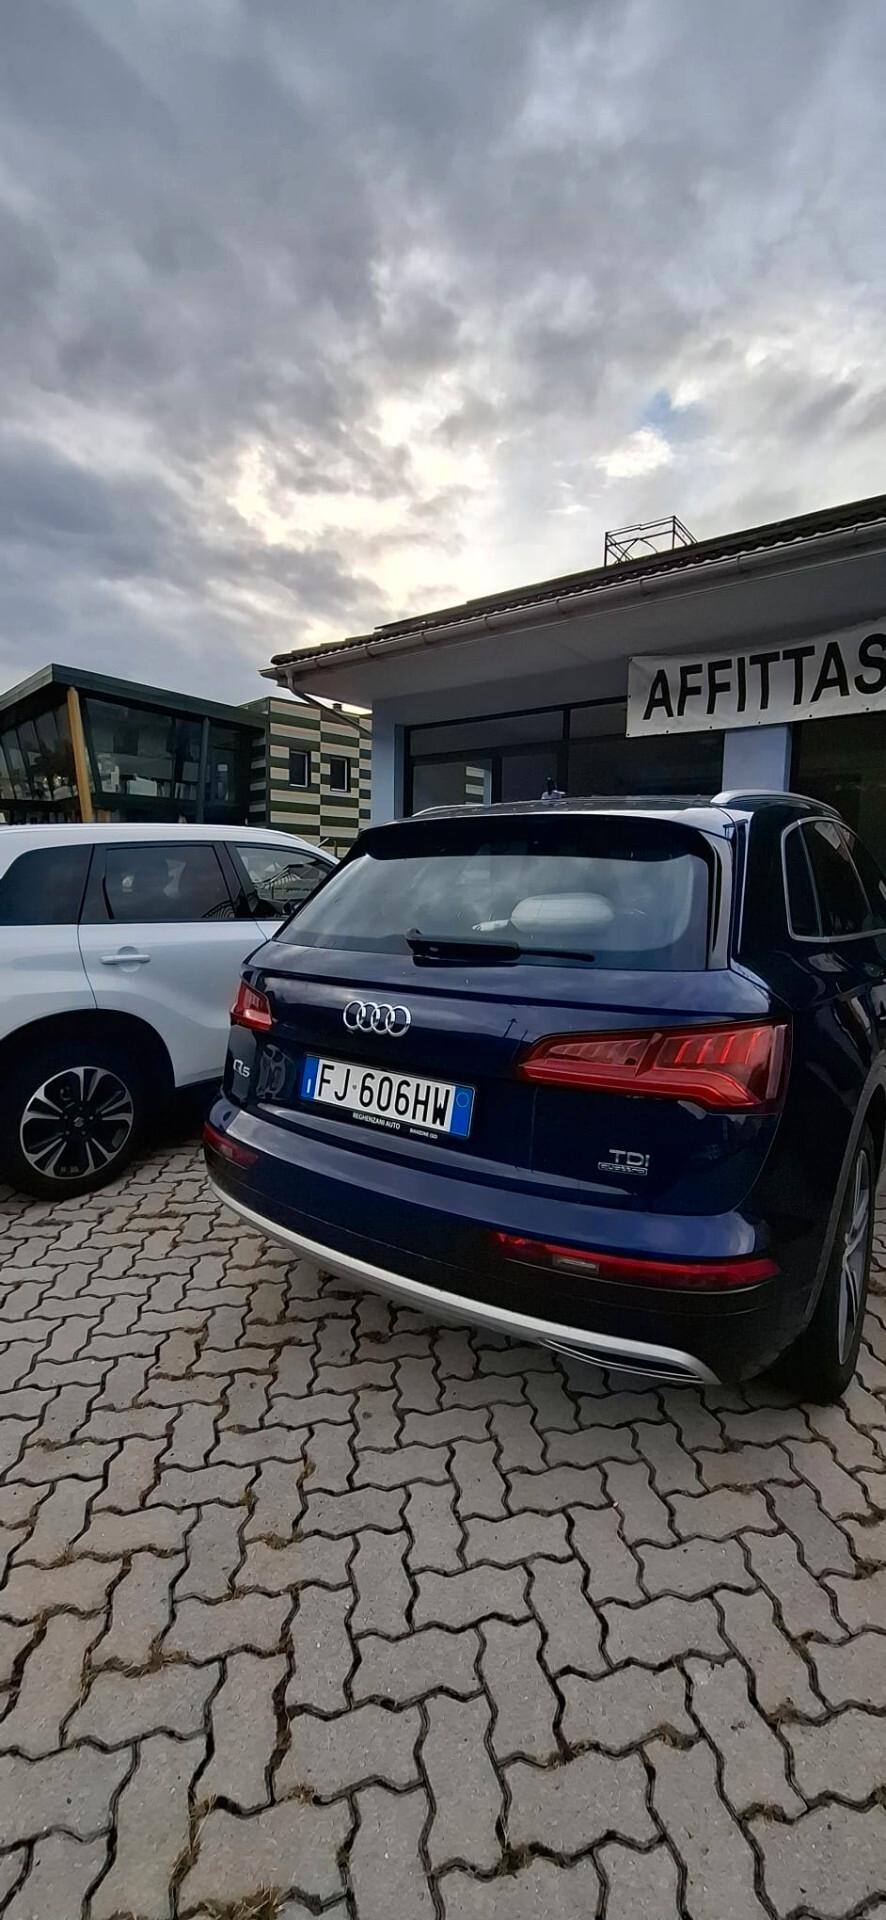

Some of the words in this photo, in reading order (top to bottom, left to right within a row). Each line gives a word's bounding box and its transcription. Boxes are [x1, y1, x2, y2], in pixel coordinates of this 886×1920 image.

[643, 633, 886, 720] AFFITTAS
[233, 1059, 250, 1077] Q5
[385, 1120, 401, 1130] AUTO
[609, 1149, 650, 1167] TDI
